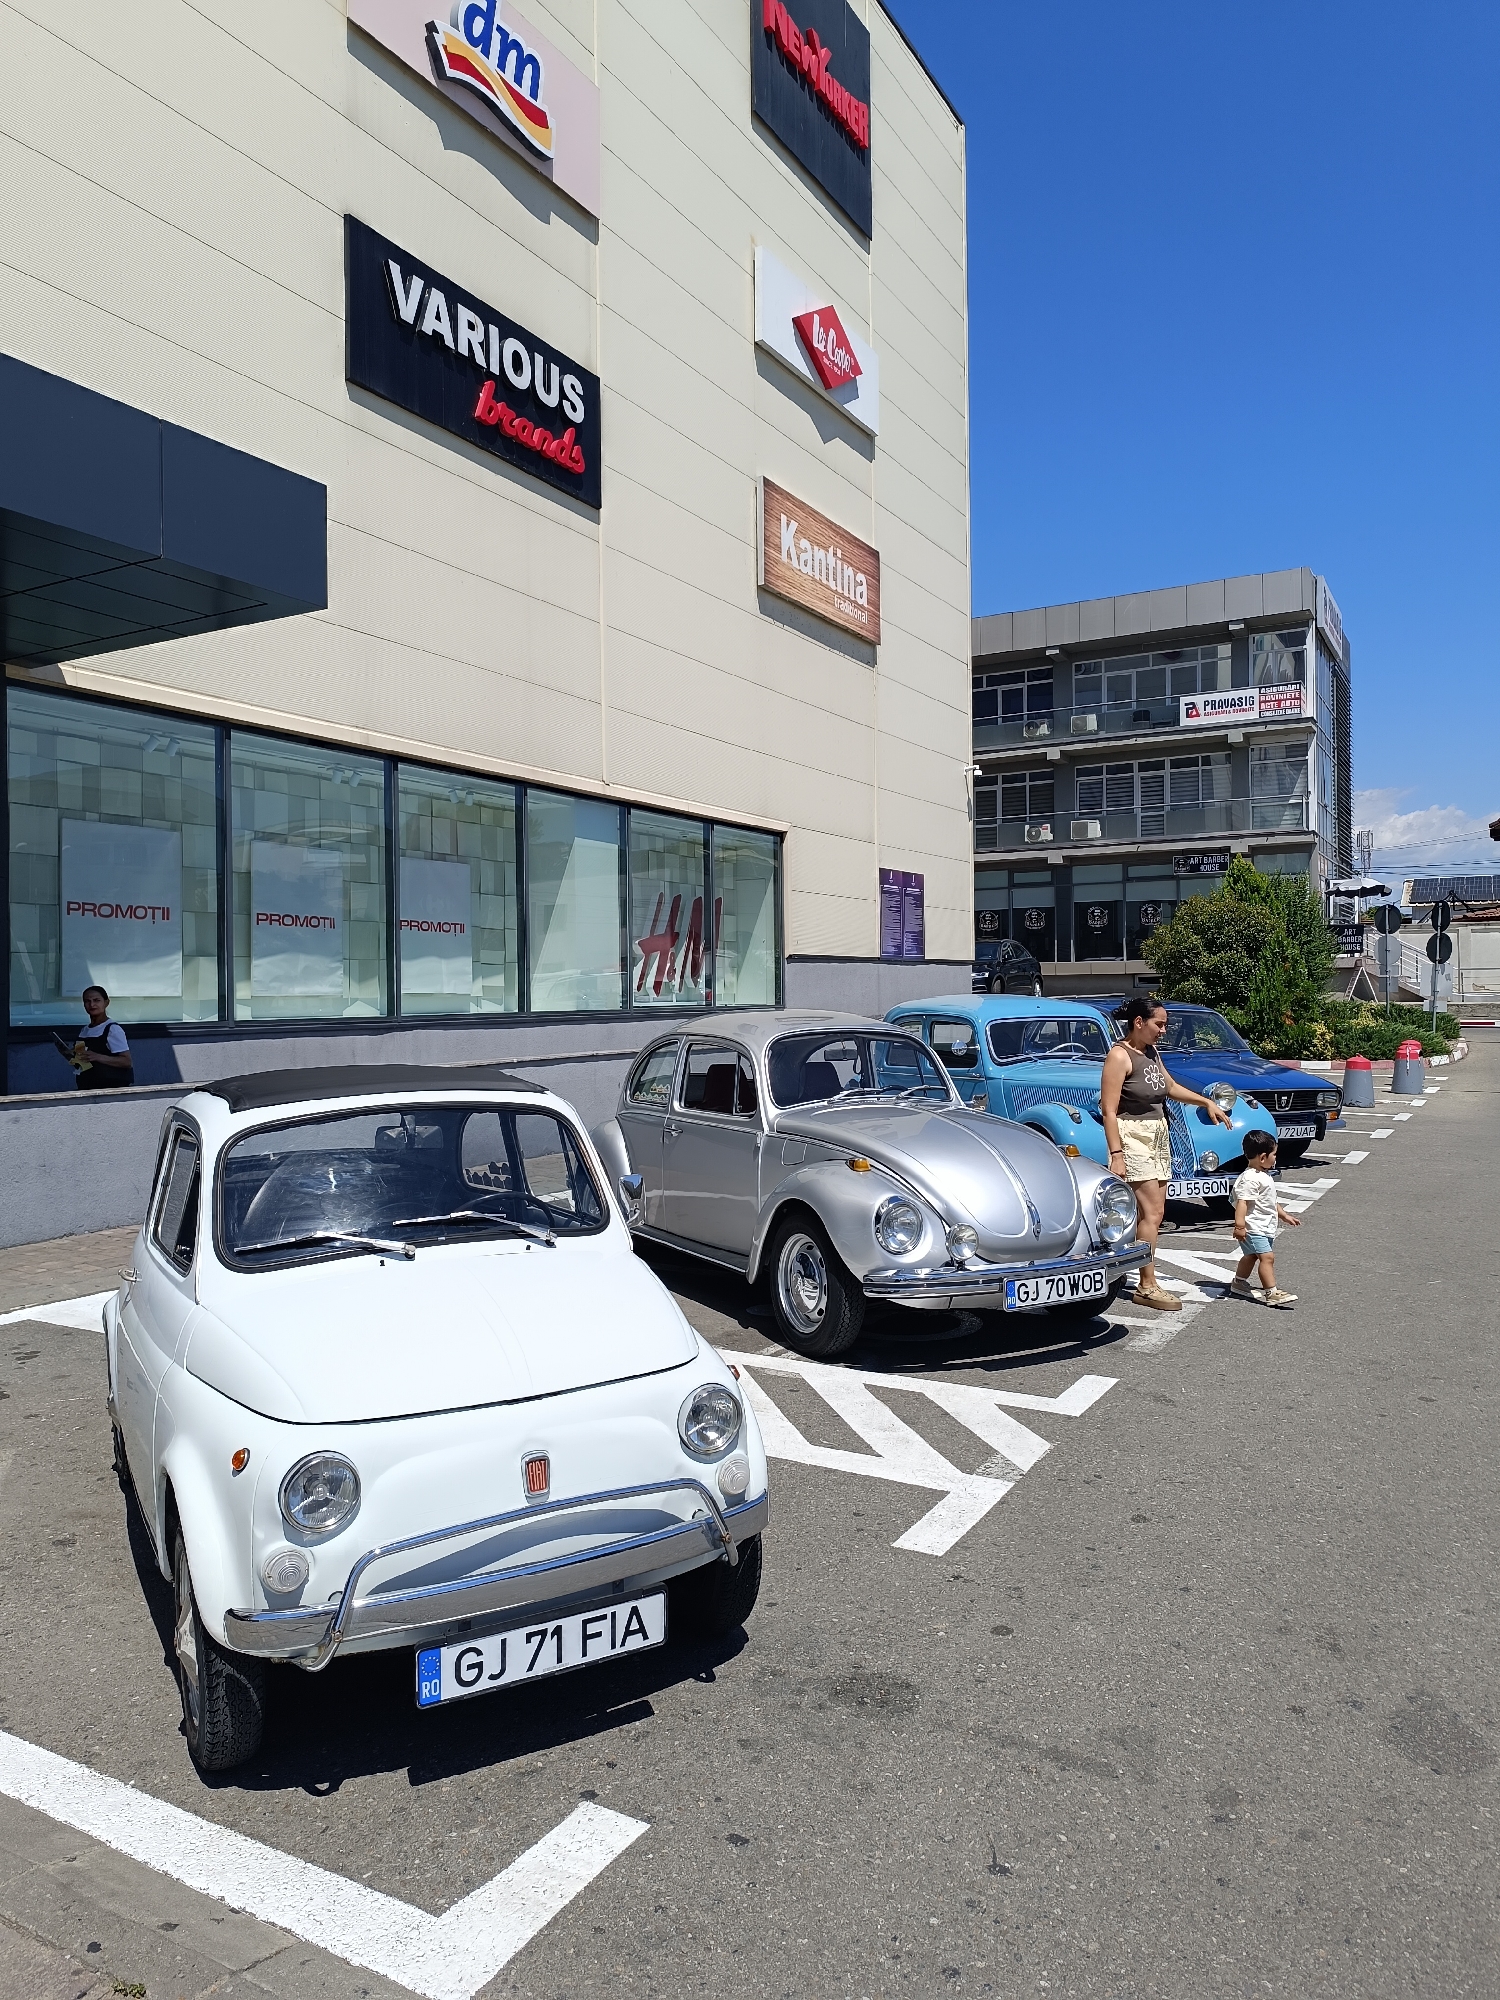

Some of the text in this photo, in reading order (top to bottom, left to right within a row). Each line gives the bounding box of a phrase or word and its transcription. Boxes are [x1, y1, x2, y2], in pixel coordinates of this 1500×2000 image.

[463, 0, 541, 102] dm
[383, 259, 585, 424] VARIOUS
[813, 313, 827, 353] Lee
[827, 328, 855, 377] Cooper
[474, 380, 586, 474] brands
[780, 513, 868, 607] Kantina
[834, 594, 868, 625] traditional
[1203, 695, 1255, 712] PRAVASIG
[1260, 701, 1279, 710] ACTE
[1190, 856, 1203, 865] ART
[1203, 855, 1229, 864] BARBER
[66, 900, 171, 925] PROMOȚII
[1337, 935, 1362, 943] BARBER
[1343, 928, 1357, 936] ART
[1167, 1183, 1182, 1198] GJ
[1017, 1281, 1040, 1303] GJ
[528, 1460, 546, 1491] FIAT
[454, 1604, 650, 1688] GJ 71 FIA
[421, 1678, 440, 1699] RO
